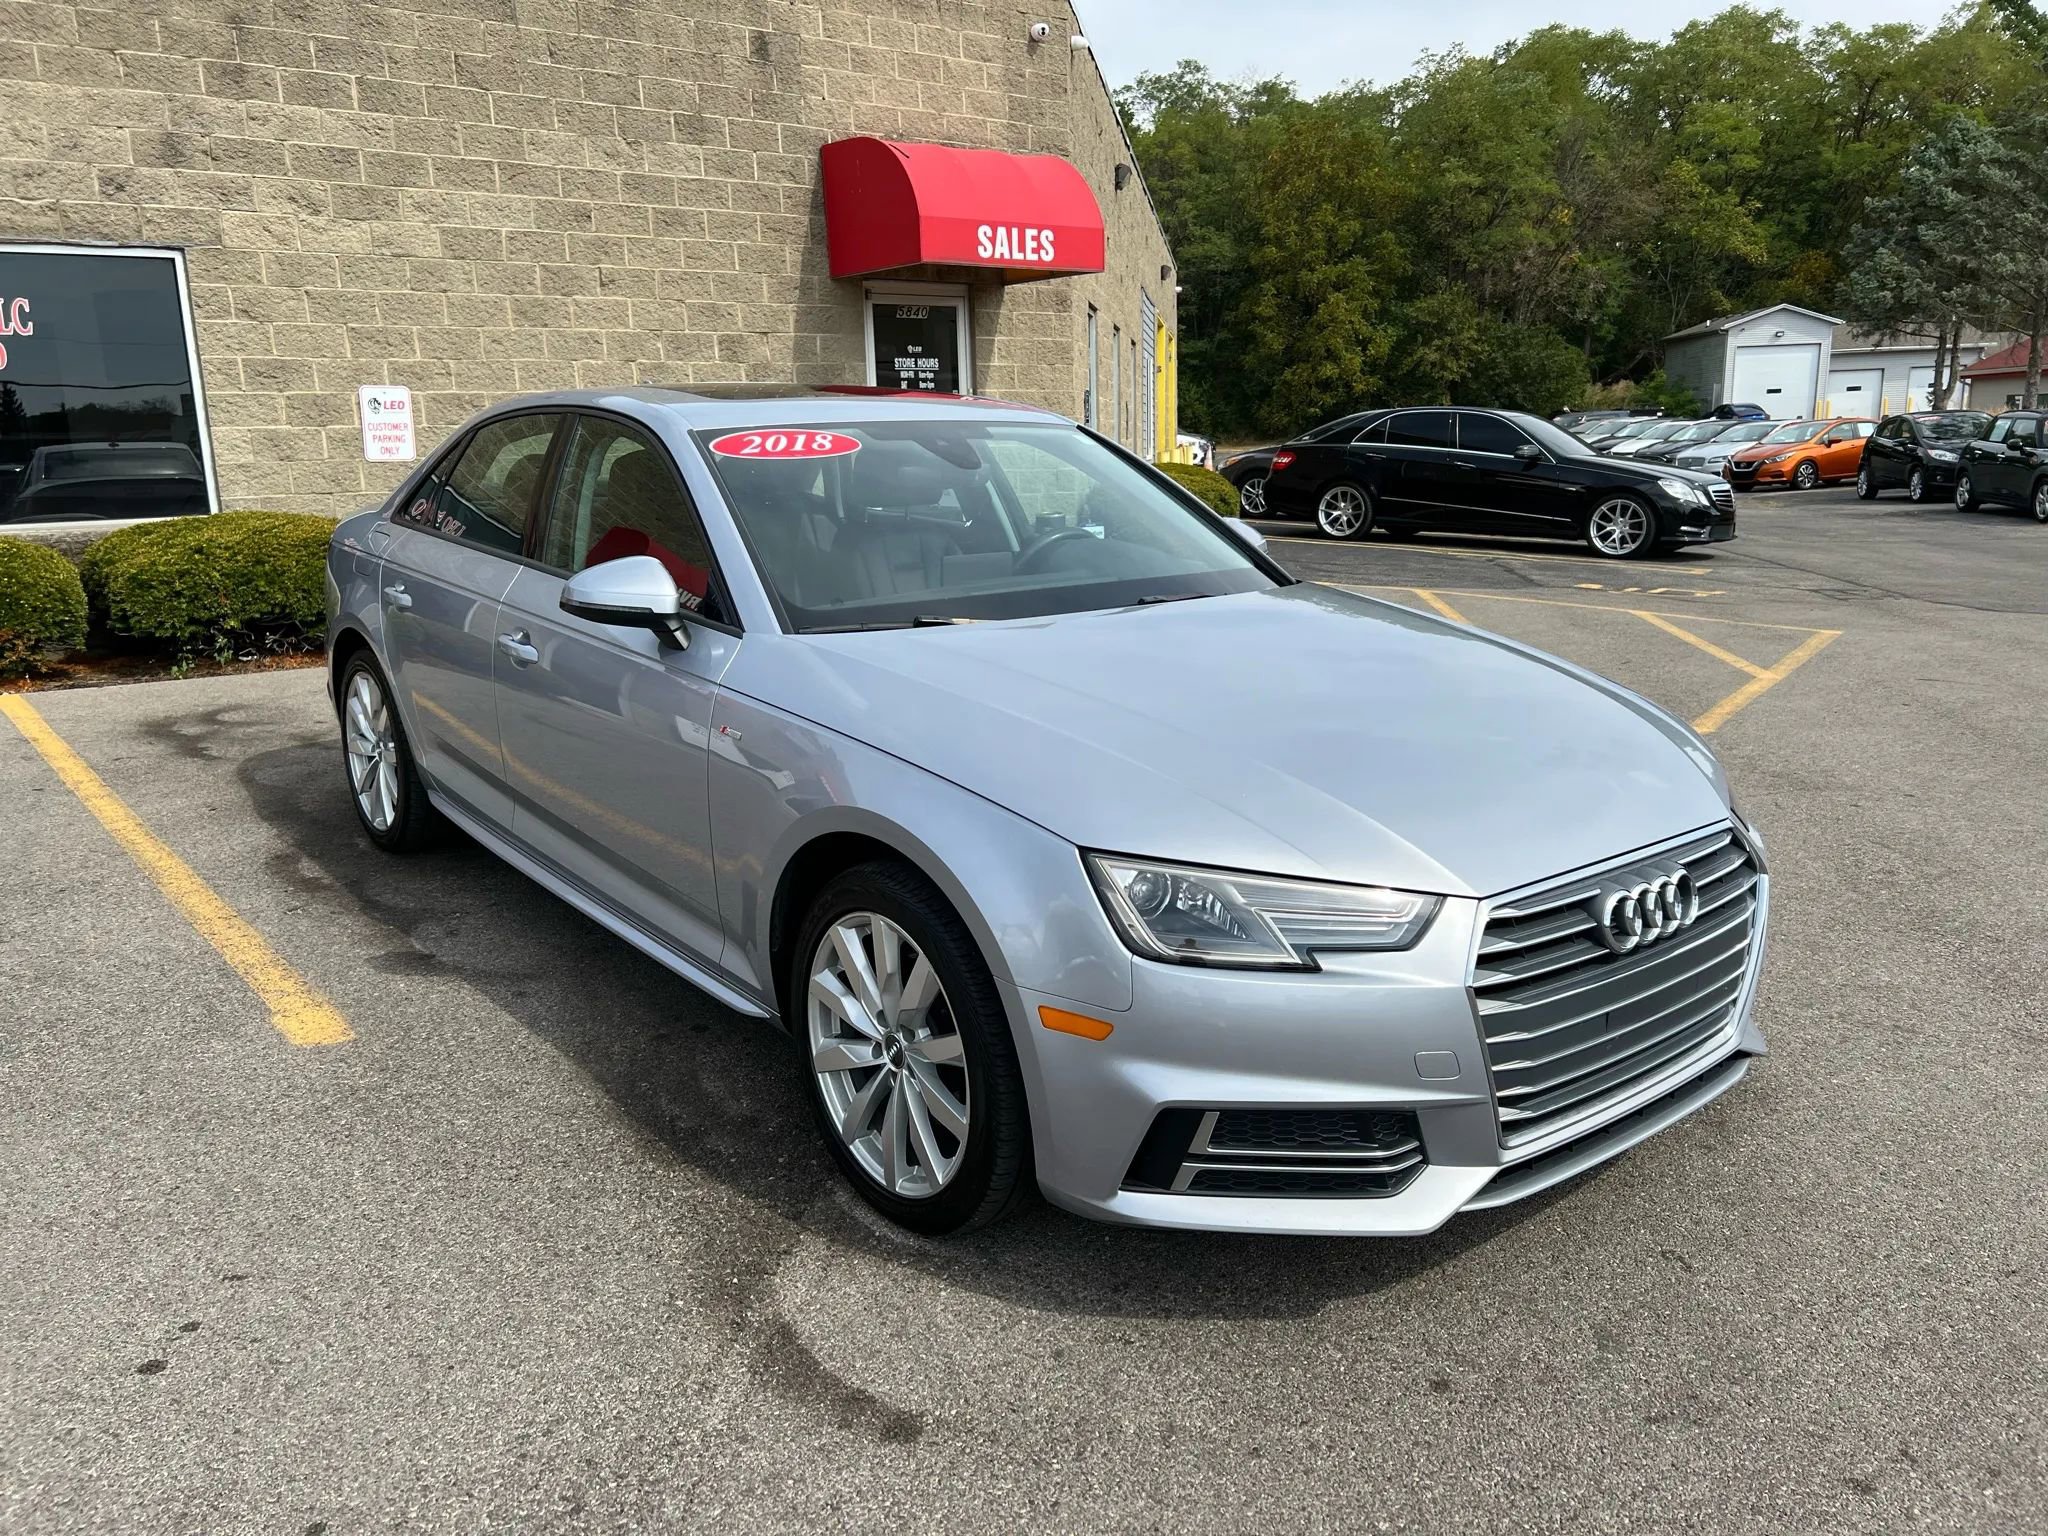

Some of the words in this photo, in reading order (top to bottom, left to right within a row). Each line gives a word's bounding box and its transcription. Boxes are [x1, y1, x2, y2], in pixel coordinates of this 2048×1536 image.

[978, 224, 1055, 262] SALES
[898, 306, 928, 317] 5840
[894, 358, 916, 368] STORE
[917, 358, 939, 368] HOURS
[383, 401, 405, 410] LEO
[367, 422, 409, 432] CUSTOMER
[372, 434, 406, 444] PARKING
[739, 433, 833, 455] 2018
[380, 446, 400, 455] ONLY
